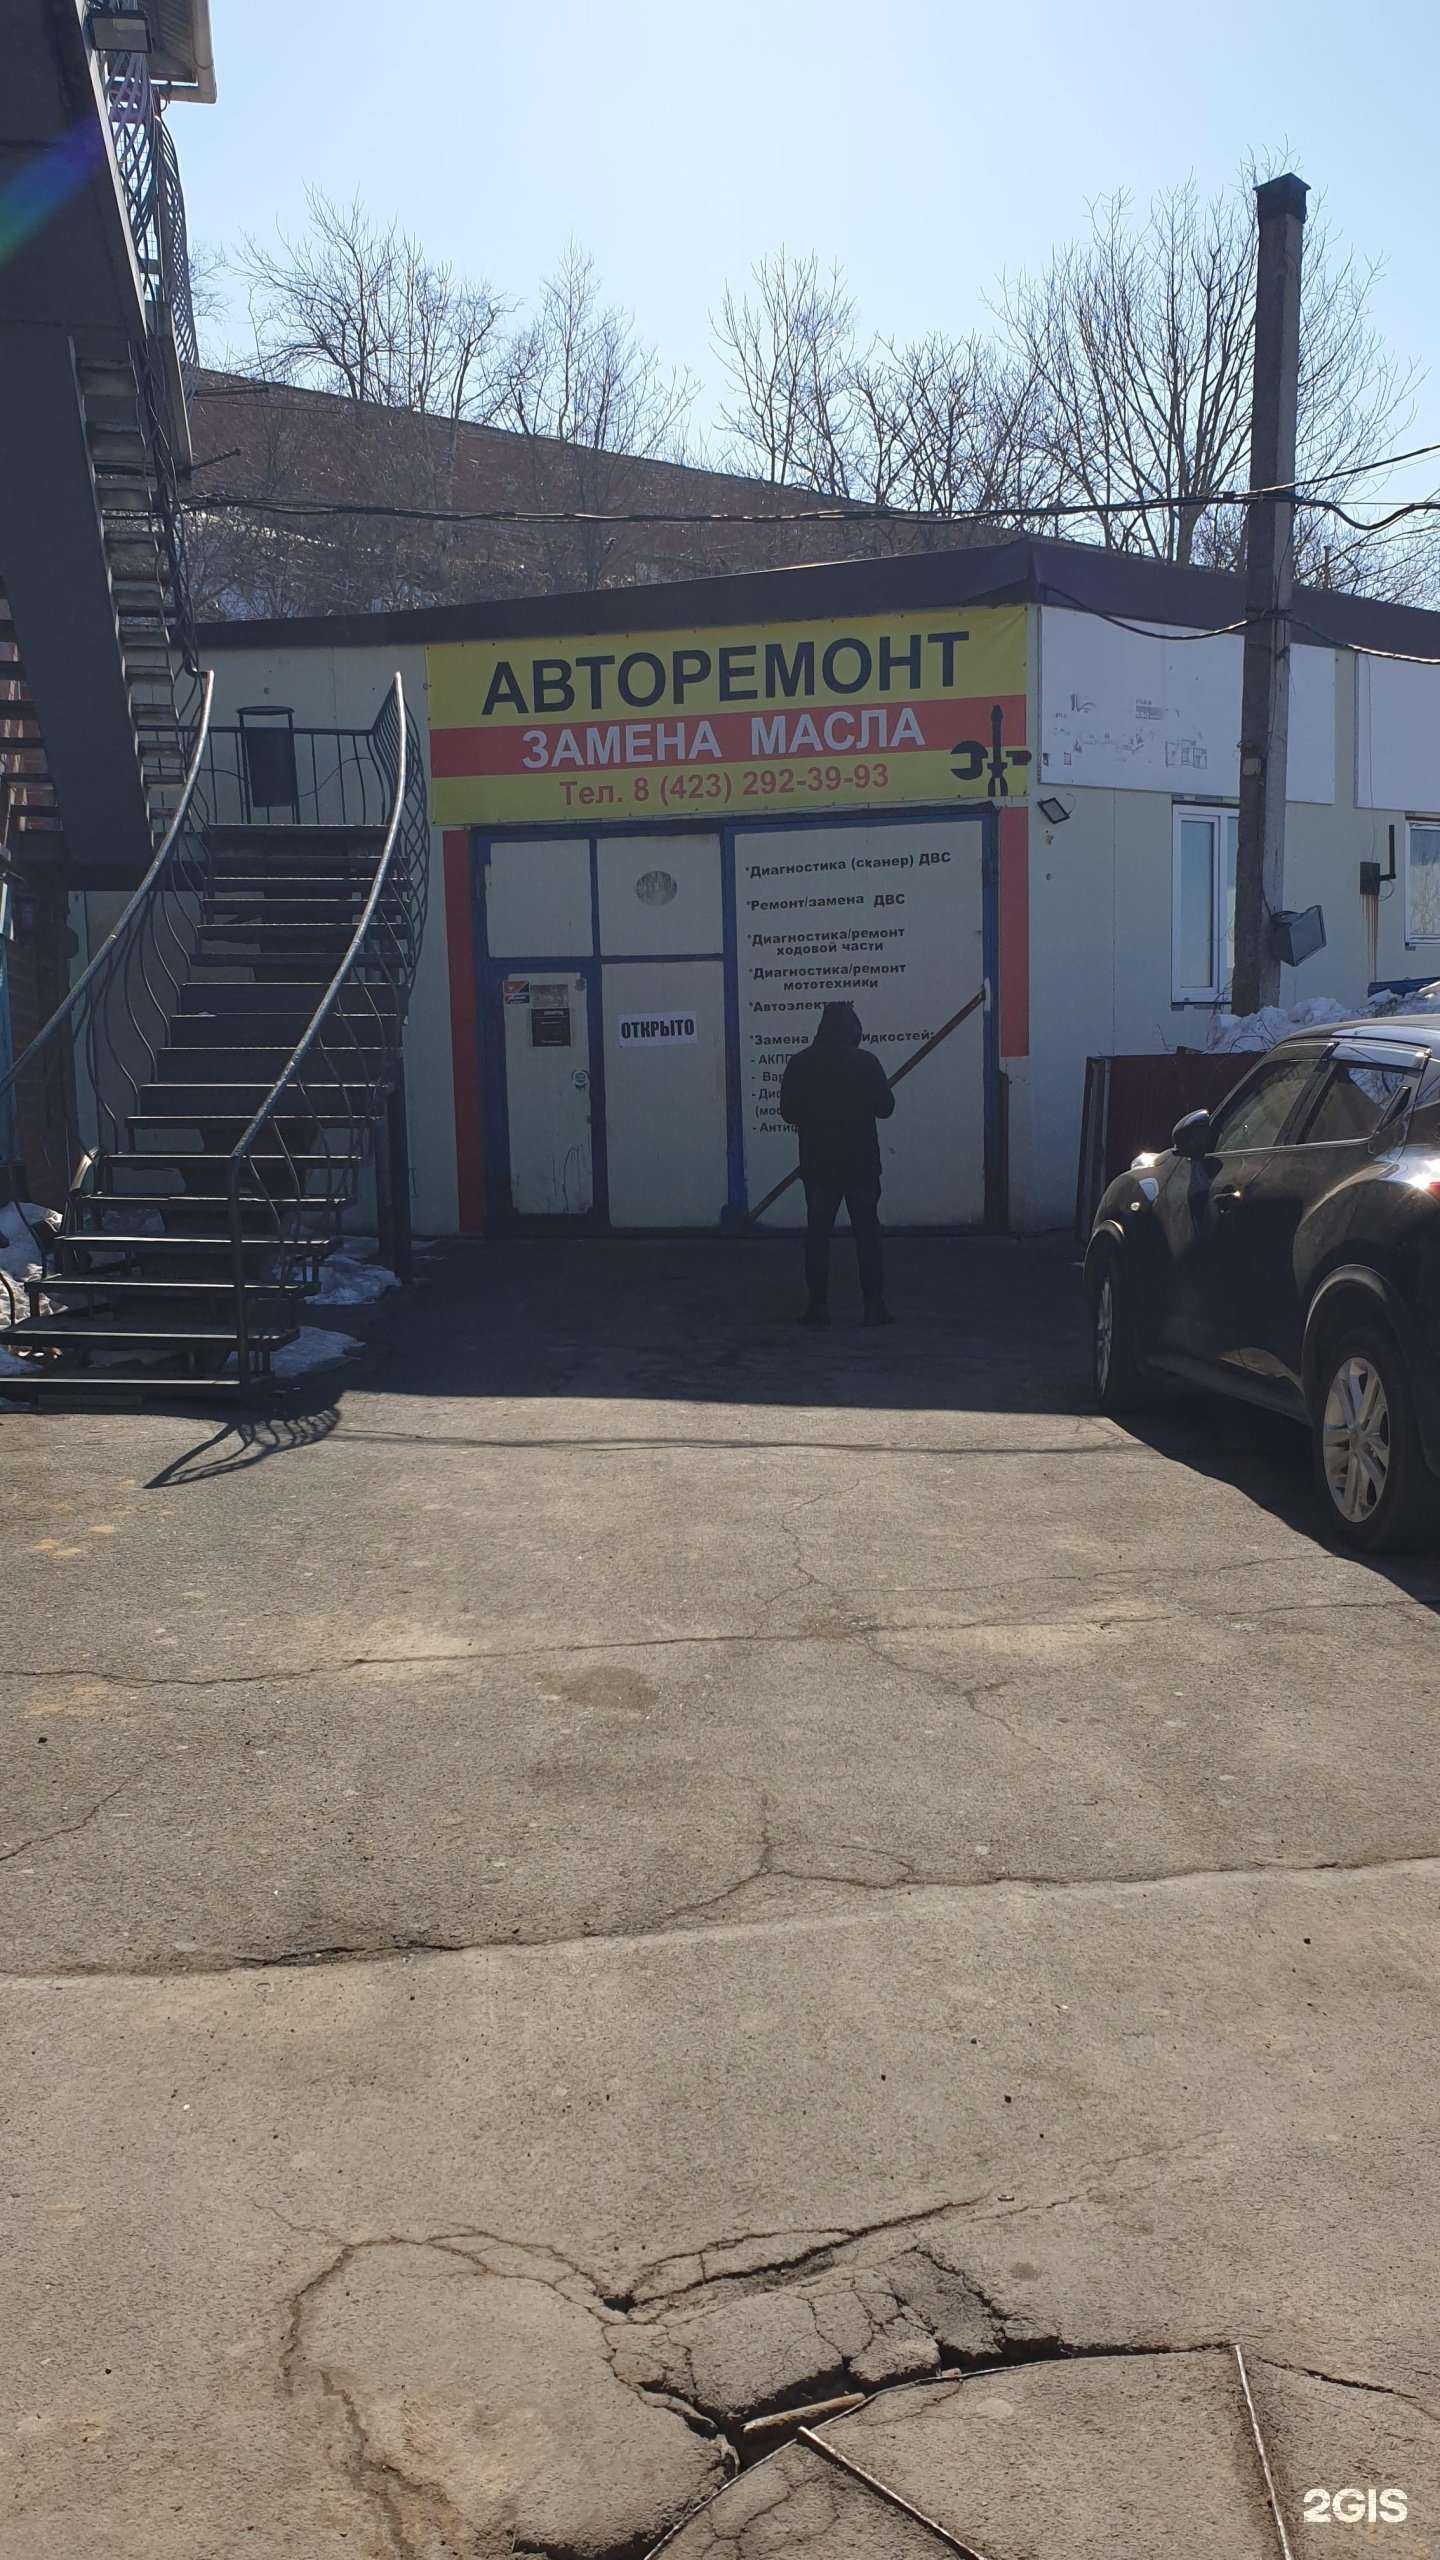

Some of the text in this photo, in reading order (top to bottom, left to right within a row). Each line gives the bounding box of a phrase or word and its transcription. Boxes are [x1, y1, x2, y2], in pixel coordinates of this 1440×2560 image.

[481, 630, 970, 716] АВТОРЕМОНТ
[521, 707, 926, 769] ЗАМЕНА МАСЛА
[559, 763, 889, 807] Тел. 8 (423) 292-39-93
[750, 851, 951, 878] Диагностика (сканер) ДВС
[751, 894, 906, 911] Ремонт/замена ДВС
[751, 928, 906, 946] Диагностика/ремонт
[776, 941, 884, 957] ходовой части
[753, 963, 907, 980] Диагностика/ремонт
[783, 979, 878, 991] мототехники
[621, 1019, 695, 1039] ОТКРЫТО
[755, 1031, 934, 1046] Замена идкостей:
